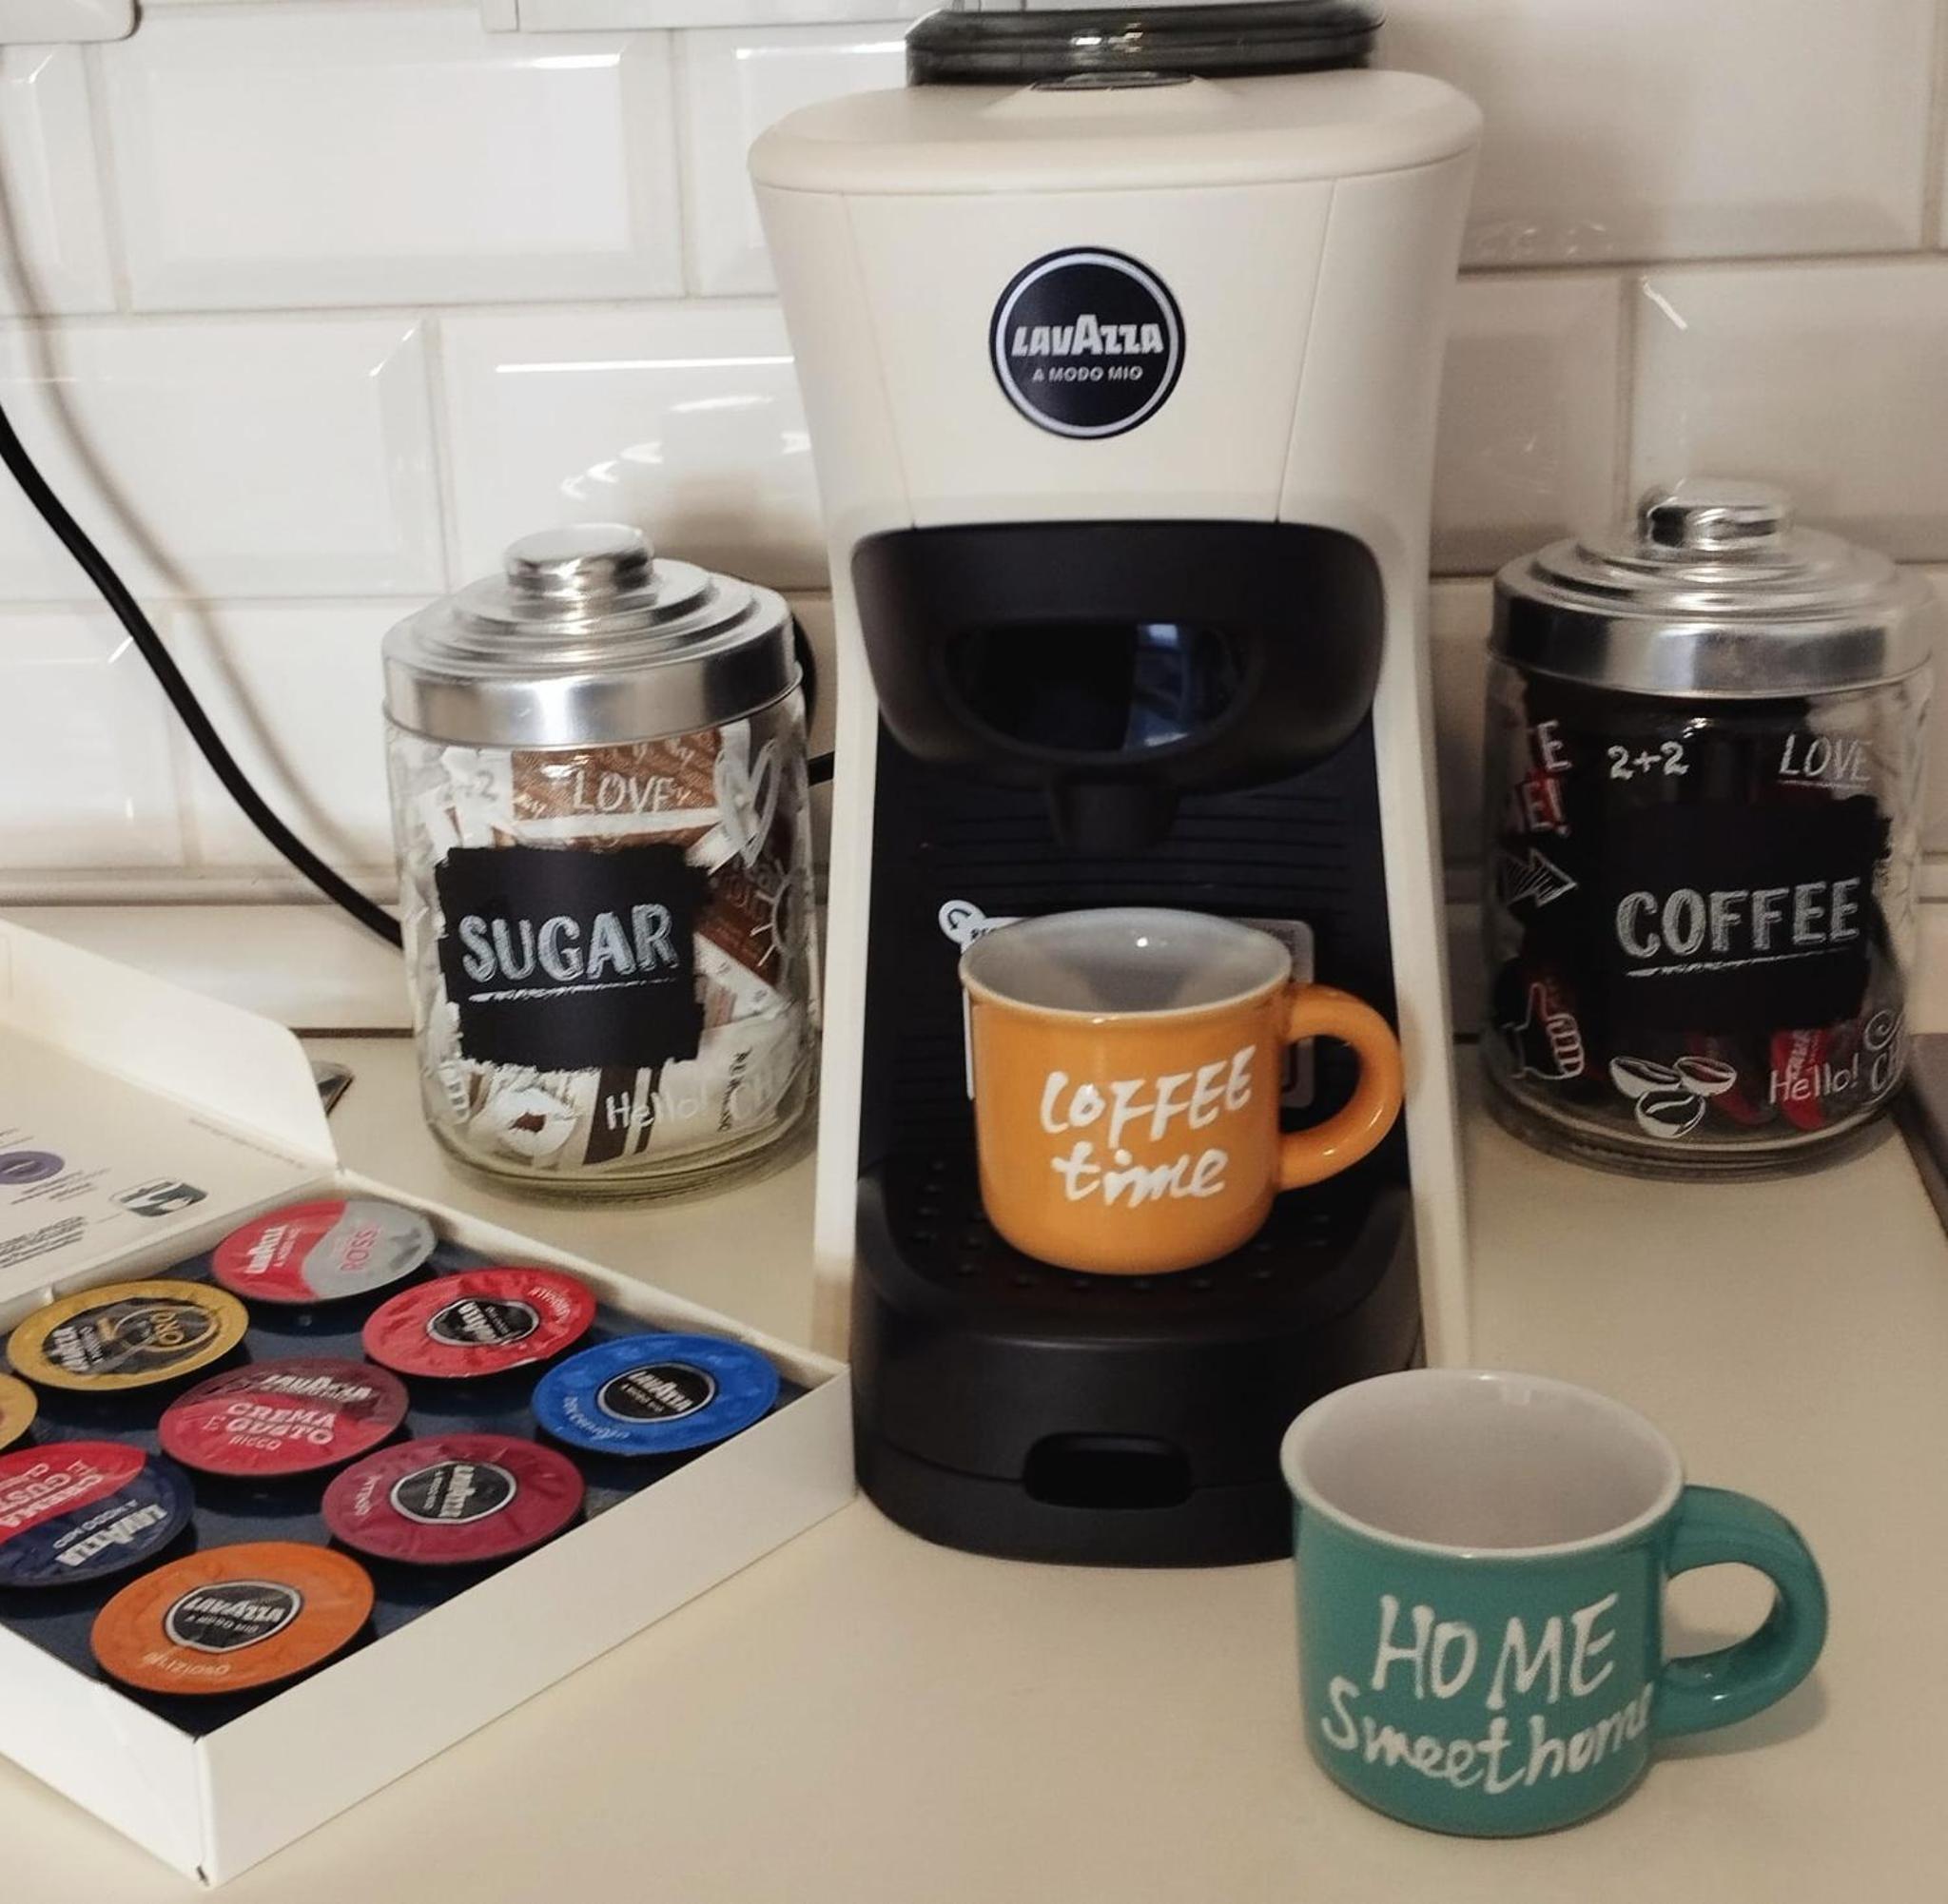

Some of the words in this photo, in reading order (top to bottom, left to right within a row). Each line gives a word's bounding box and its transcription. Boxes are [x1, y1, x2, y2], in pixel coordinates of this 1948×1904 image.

[1011, 315, 1164, 357] LAVAZZA
[1033, 368, 1045, 382] A
[1048, 366, 1104, 382] MODO
[1108, 365, 1144, 380] MIO
[1607, 740, 1690, 780] 2+2
[1779, 732, 1873, 782] LOVE
[572, 767, 673, 814] LOVE
[458, 903, 679, 982] SUGAR
[1616, 877, 1860, 958] COFFEE
[1041, 1044, 1256, 1149] COFFEE
[1769, 1052, 1859, 1104] Hello!
[1051, 1140, 1229, 1208] time
[1372, 1592, 1619, 1710] HOME
